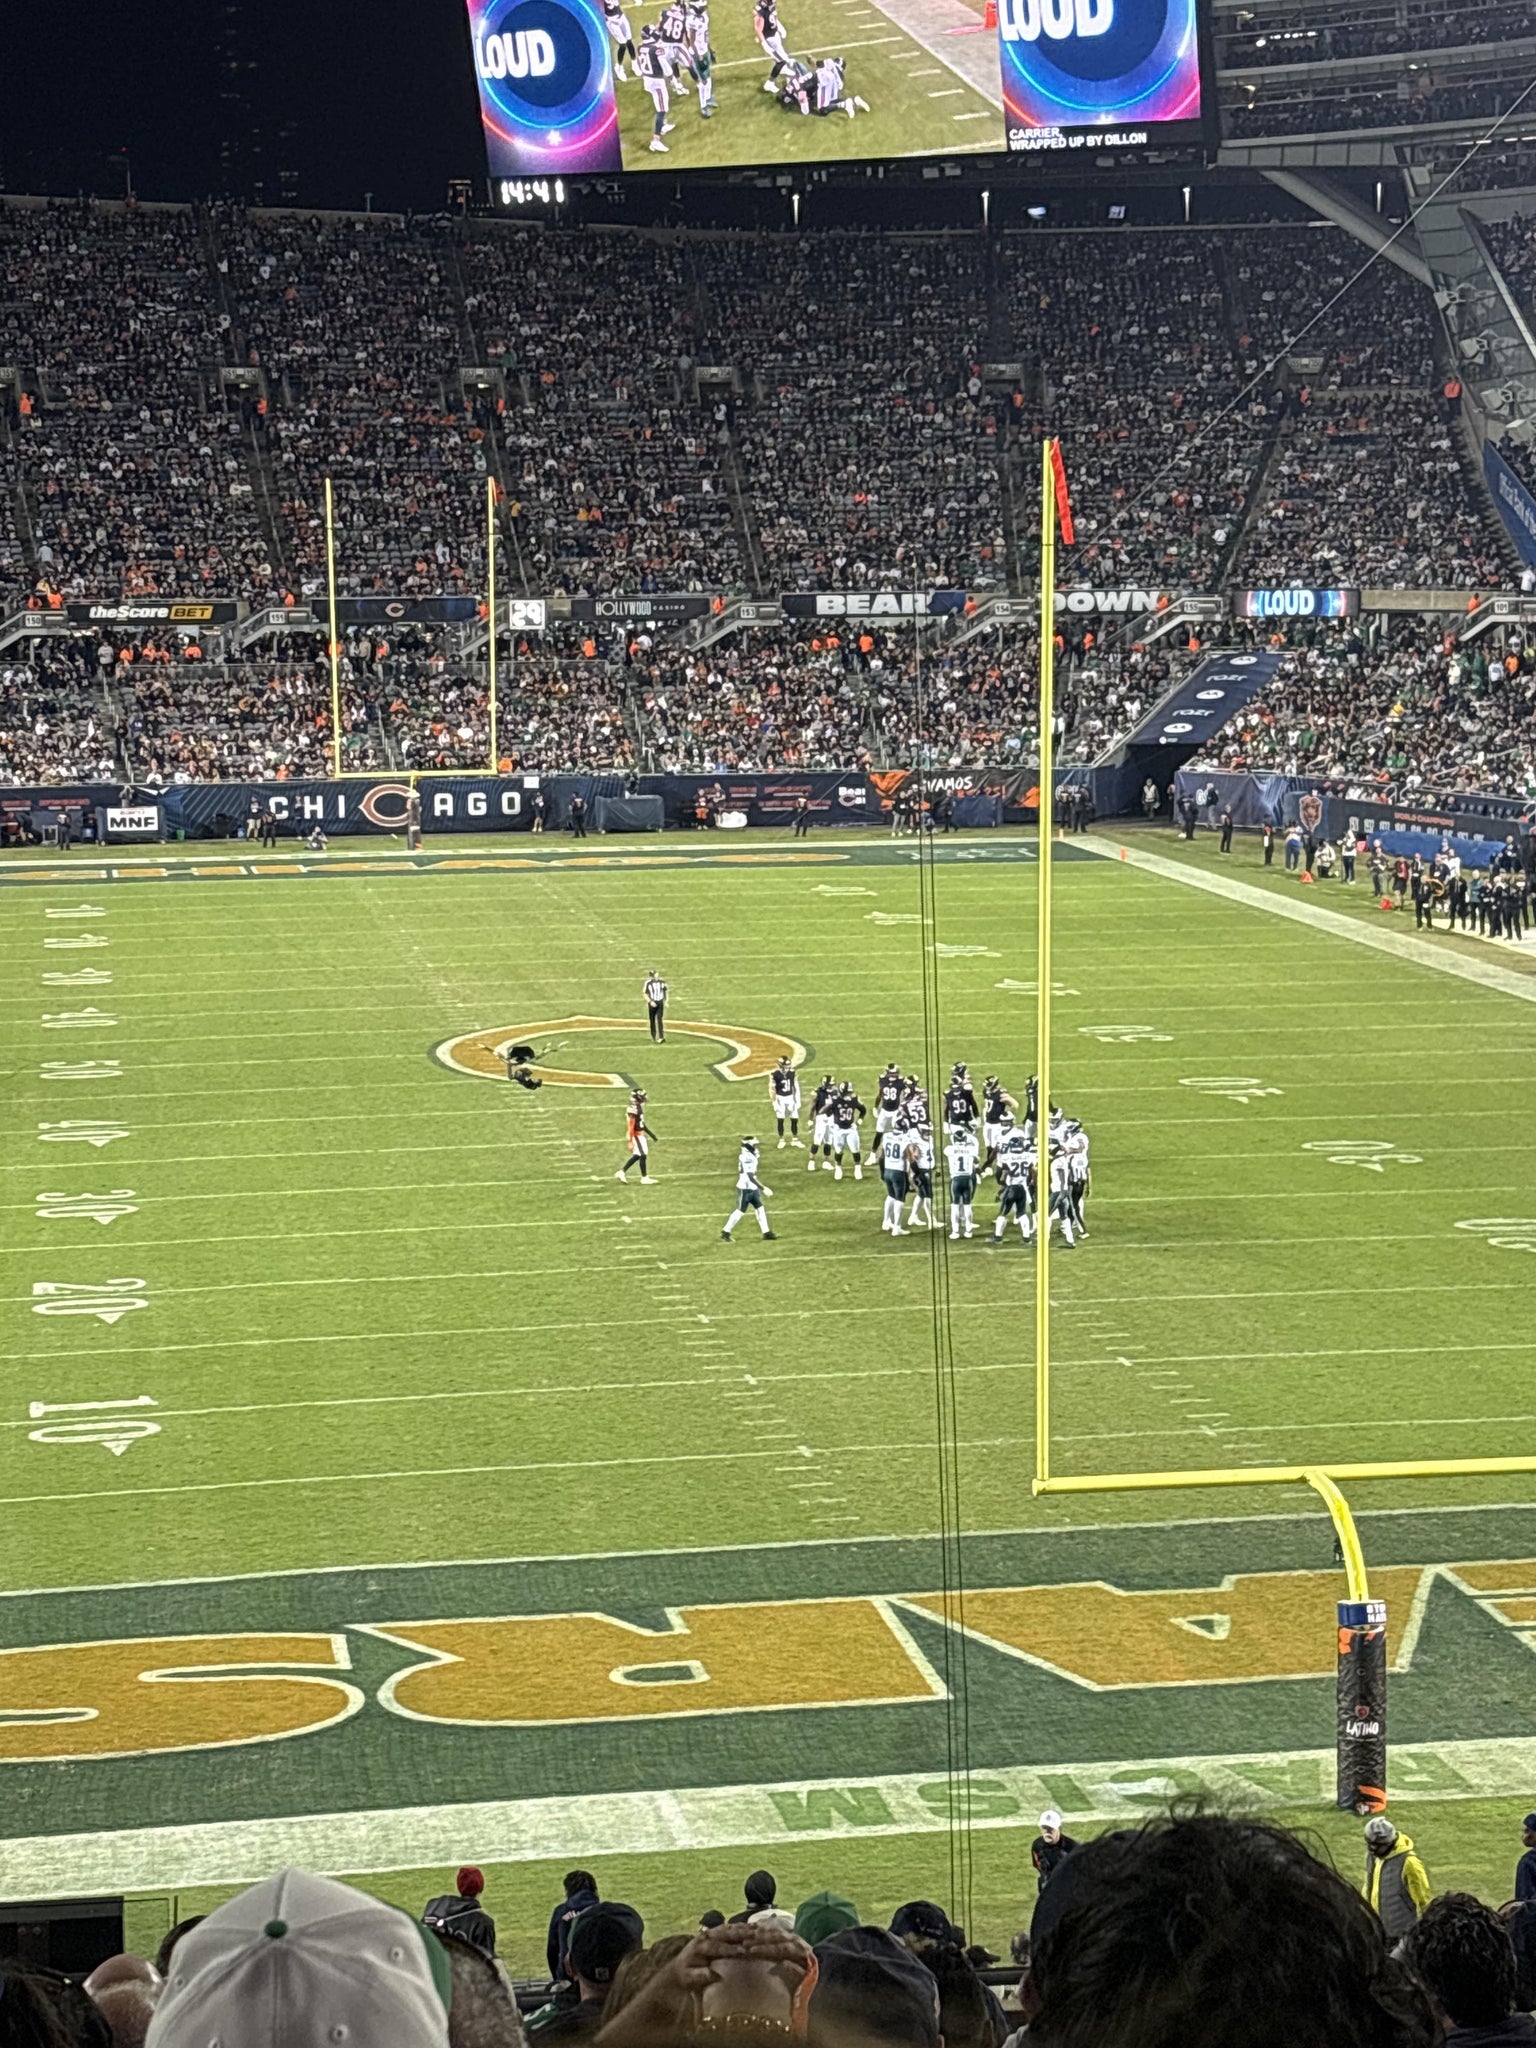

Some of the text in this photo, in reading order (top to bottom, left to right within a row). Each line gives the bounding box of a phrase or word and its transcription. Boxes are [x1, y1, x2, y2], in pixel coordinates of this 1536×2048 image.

[1000, 0, 1113, 41] LOUD
[476, 29, 556, 79] LOUD
[1009, 127, 1063, 140] CARRIER,
[1009, 132, 1147, 151] WRAPPED UP BY DILLON
[501, 179, 565, 205] 14:41
[596, 602, 652, 616] HOLLYWOOD
[816, 594, 931, 615] BEAR
[1264, 590, 1315, 615] LOUD
[89, 606, 209, 620] theScore BET
[511, 602, 542, 627] 29
[110, 817, 158, 829] MNF
[780, 1079, 791, 1092] 31
[883, 1087, 897, 1101] 98
[908, 1106, 926, 1123] 53
[952, 1099, 966, 1114] 93
[885, 1142, 900, 1159] 68
[957, 1156, 966, 1171] 1
[1011, 1161, 1029, 1177] 26
[1346, 1720, 1379, 1737] LATINO
